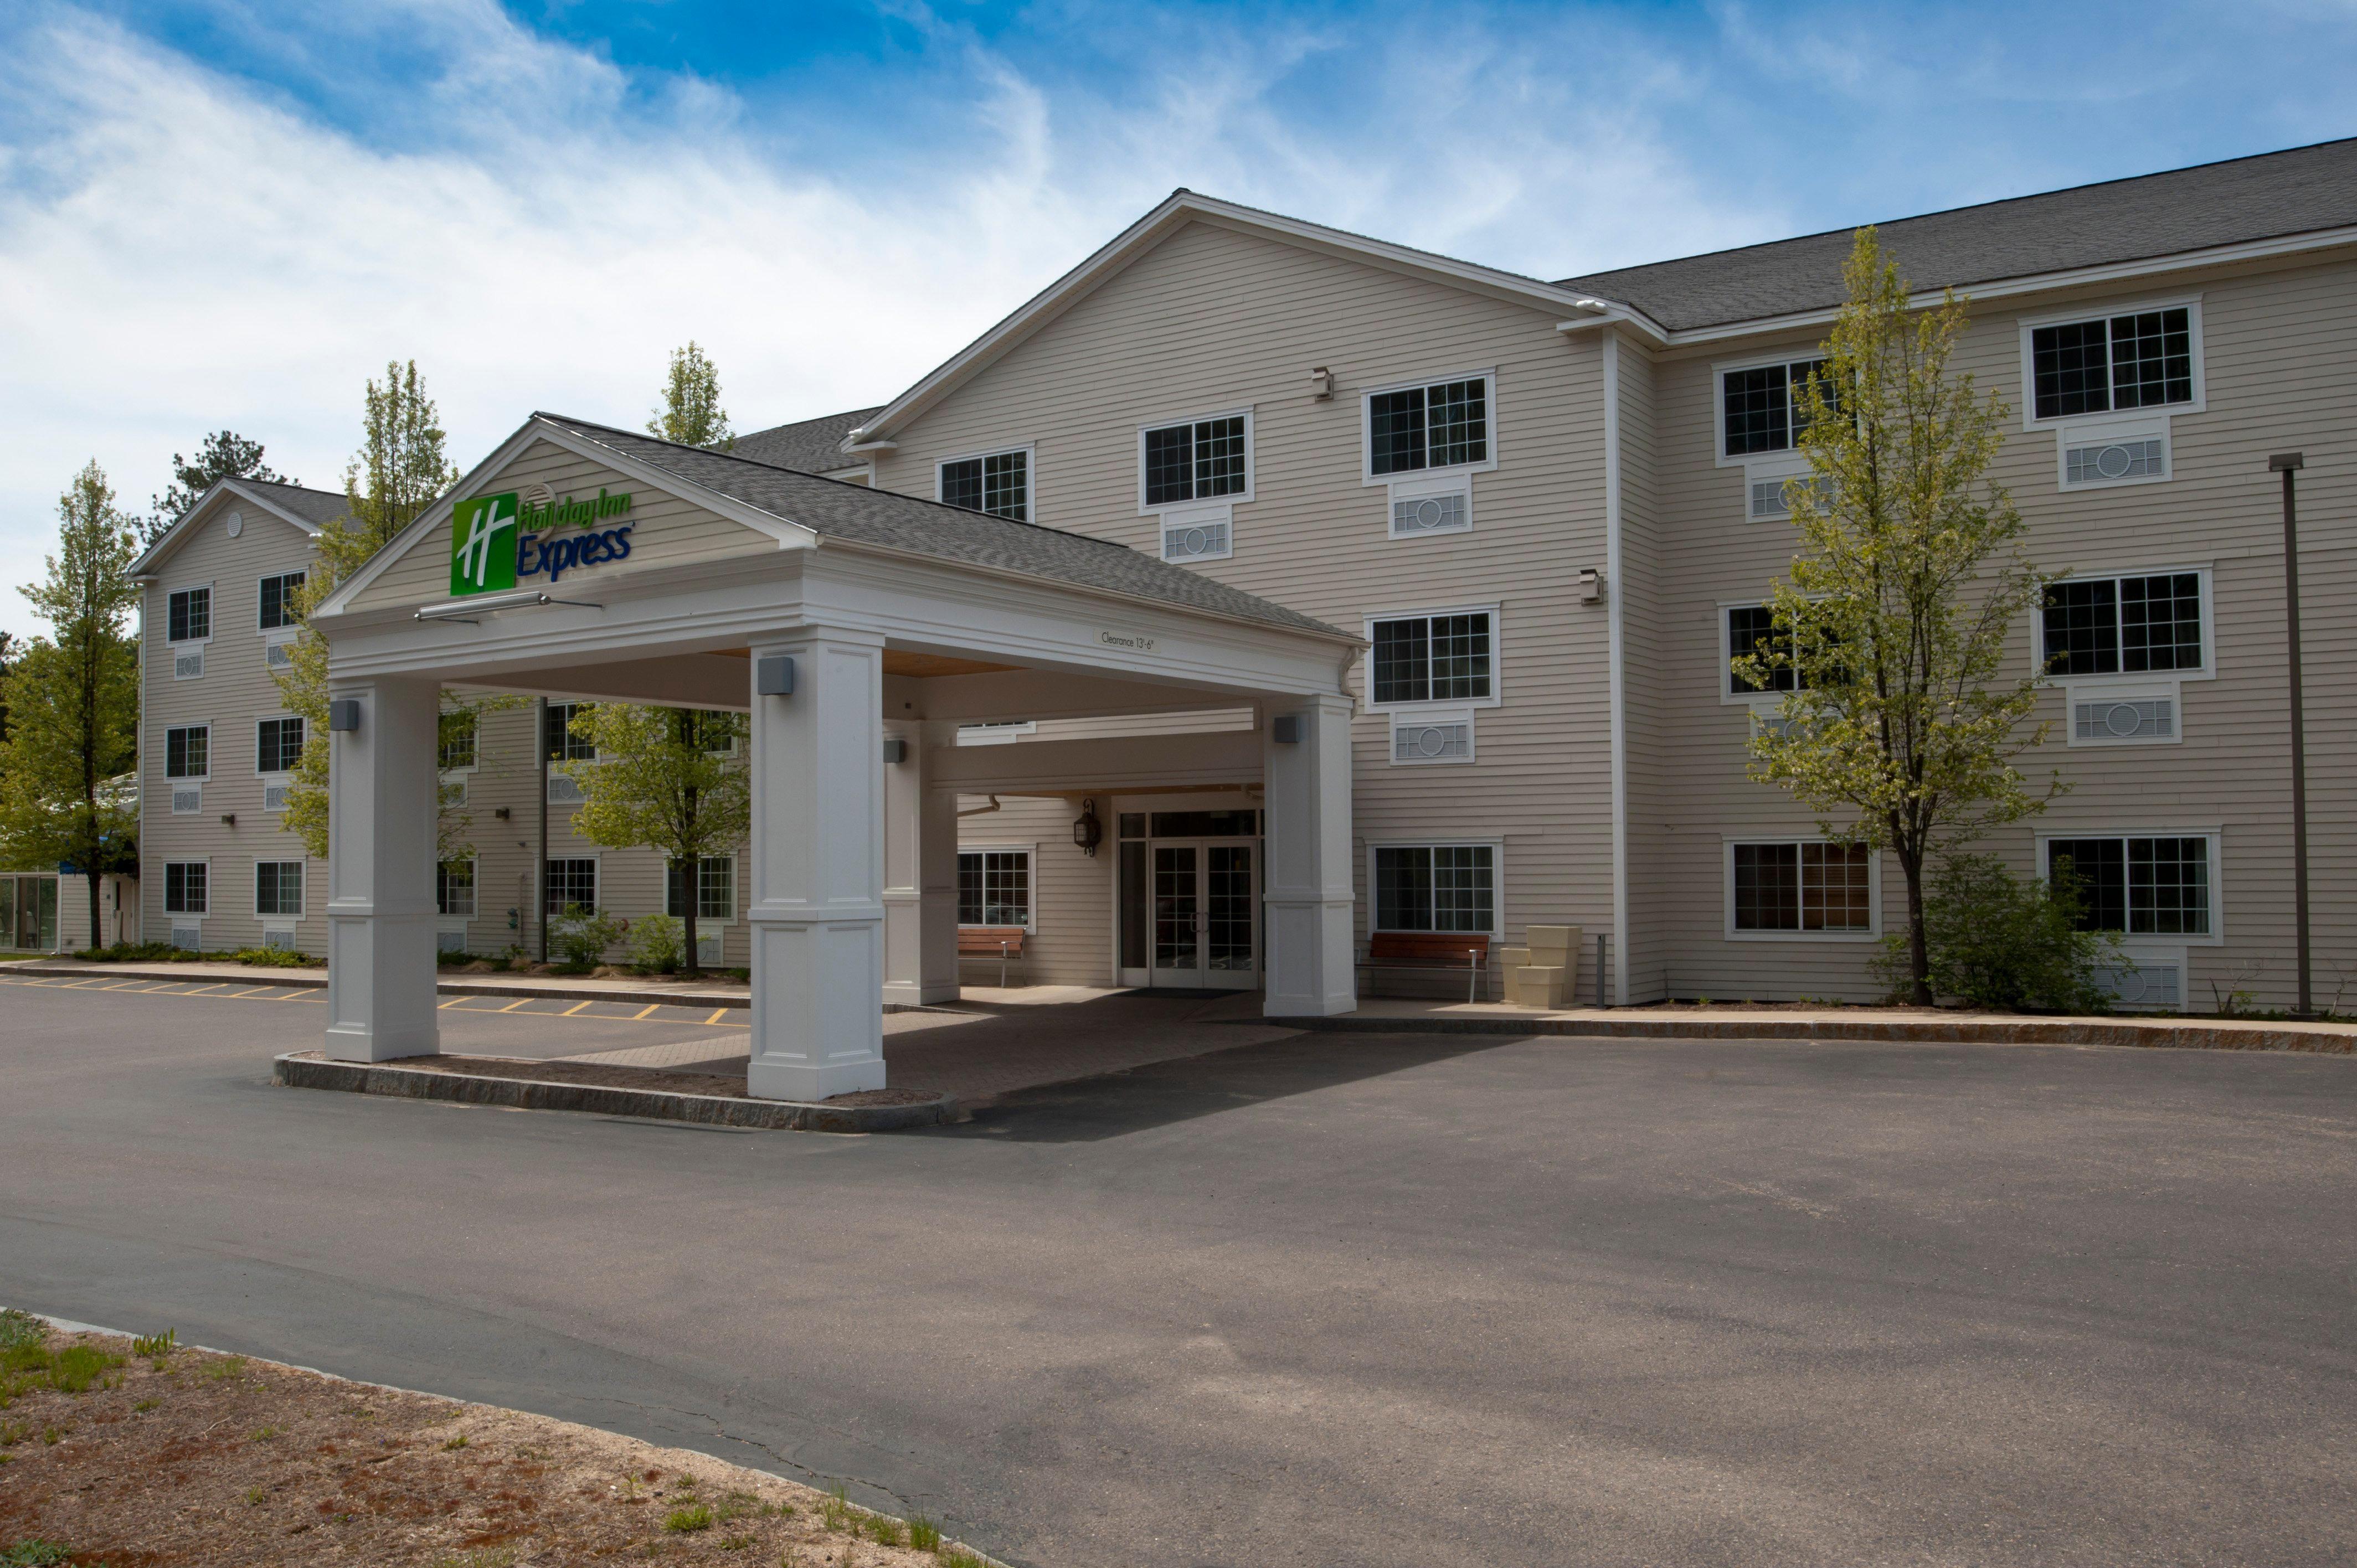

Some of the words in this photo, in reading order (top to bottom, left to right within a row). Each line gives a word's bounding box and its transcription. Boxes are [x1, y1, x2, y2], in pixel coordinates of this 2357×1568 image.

[516, 496, 595, 532] Holiday
[596, 488, 631, 518] Inn
[457, 501, 515, 586] H
[517, 527, 632, 582] Express
[1102, 631, 1134, 647] Clearance
